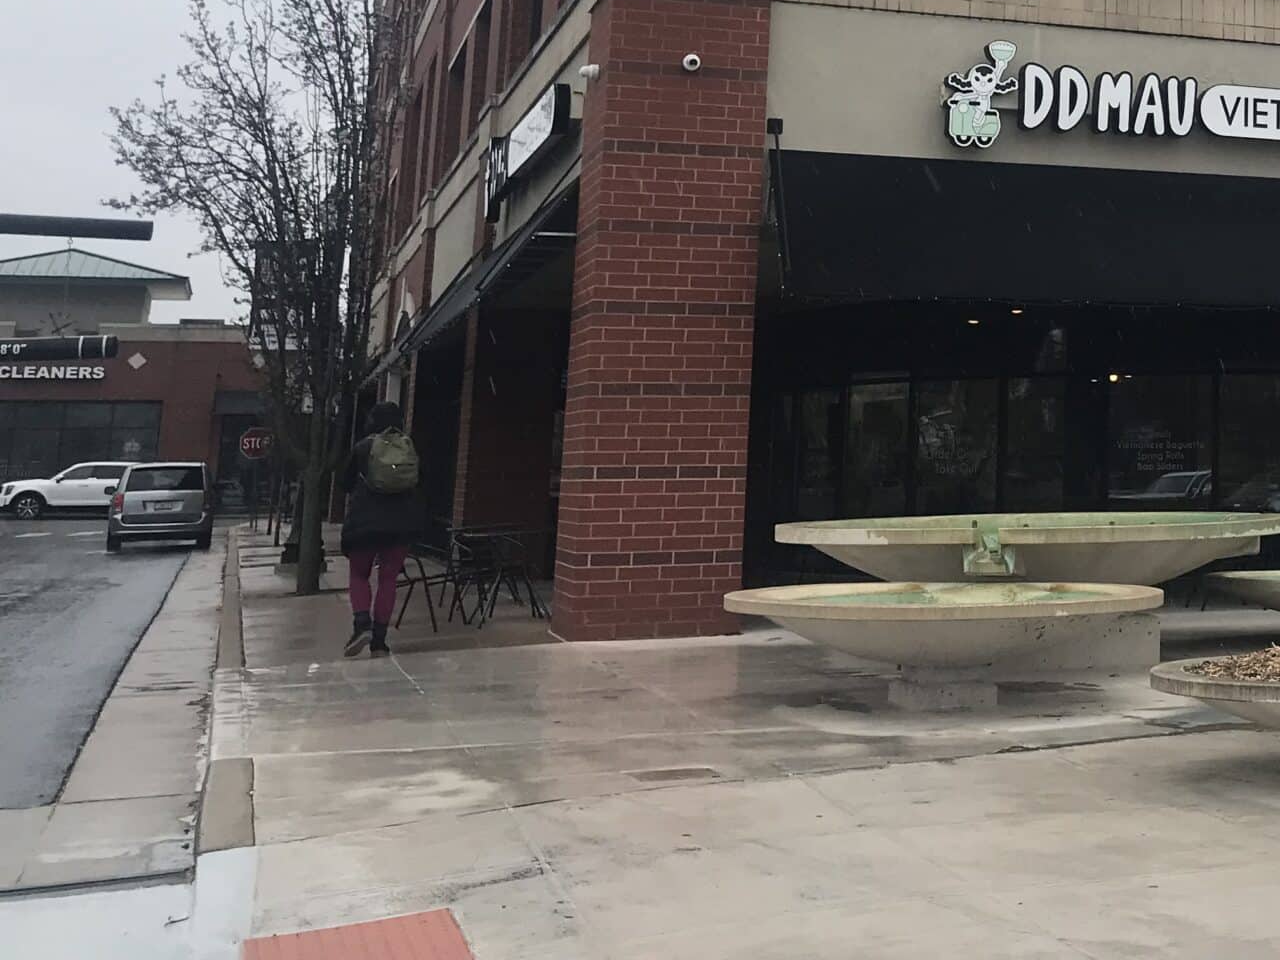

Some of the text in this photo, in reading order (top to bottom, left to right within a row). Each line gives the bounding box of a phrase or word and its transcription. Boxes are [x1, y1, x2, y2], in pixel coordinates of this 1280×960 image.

[1022, 64, 1198, 138] DD MAU
[0, 366, 105, 379] CLEANERS
